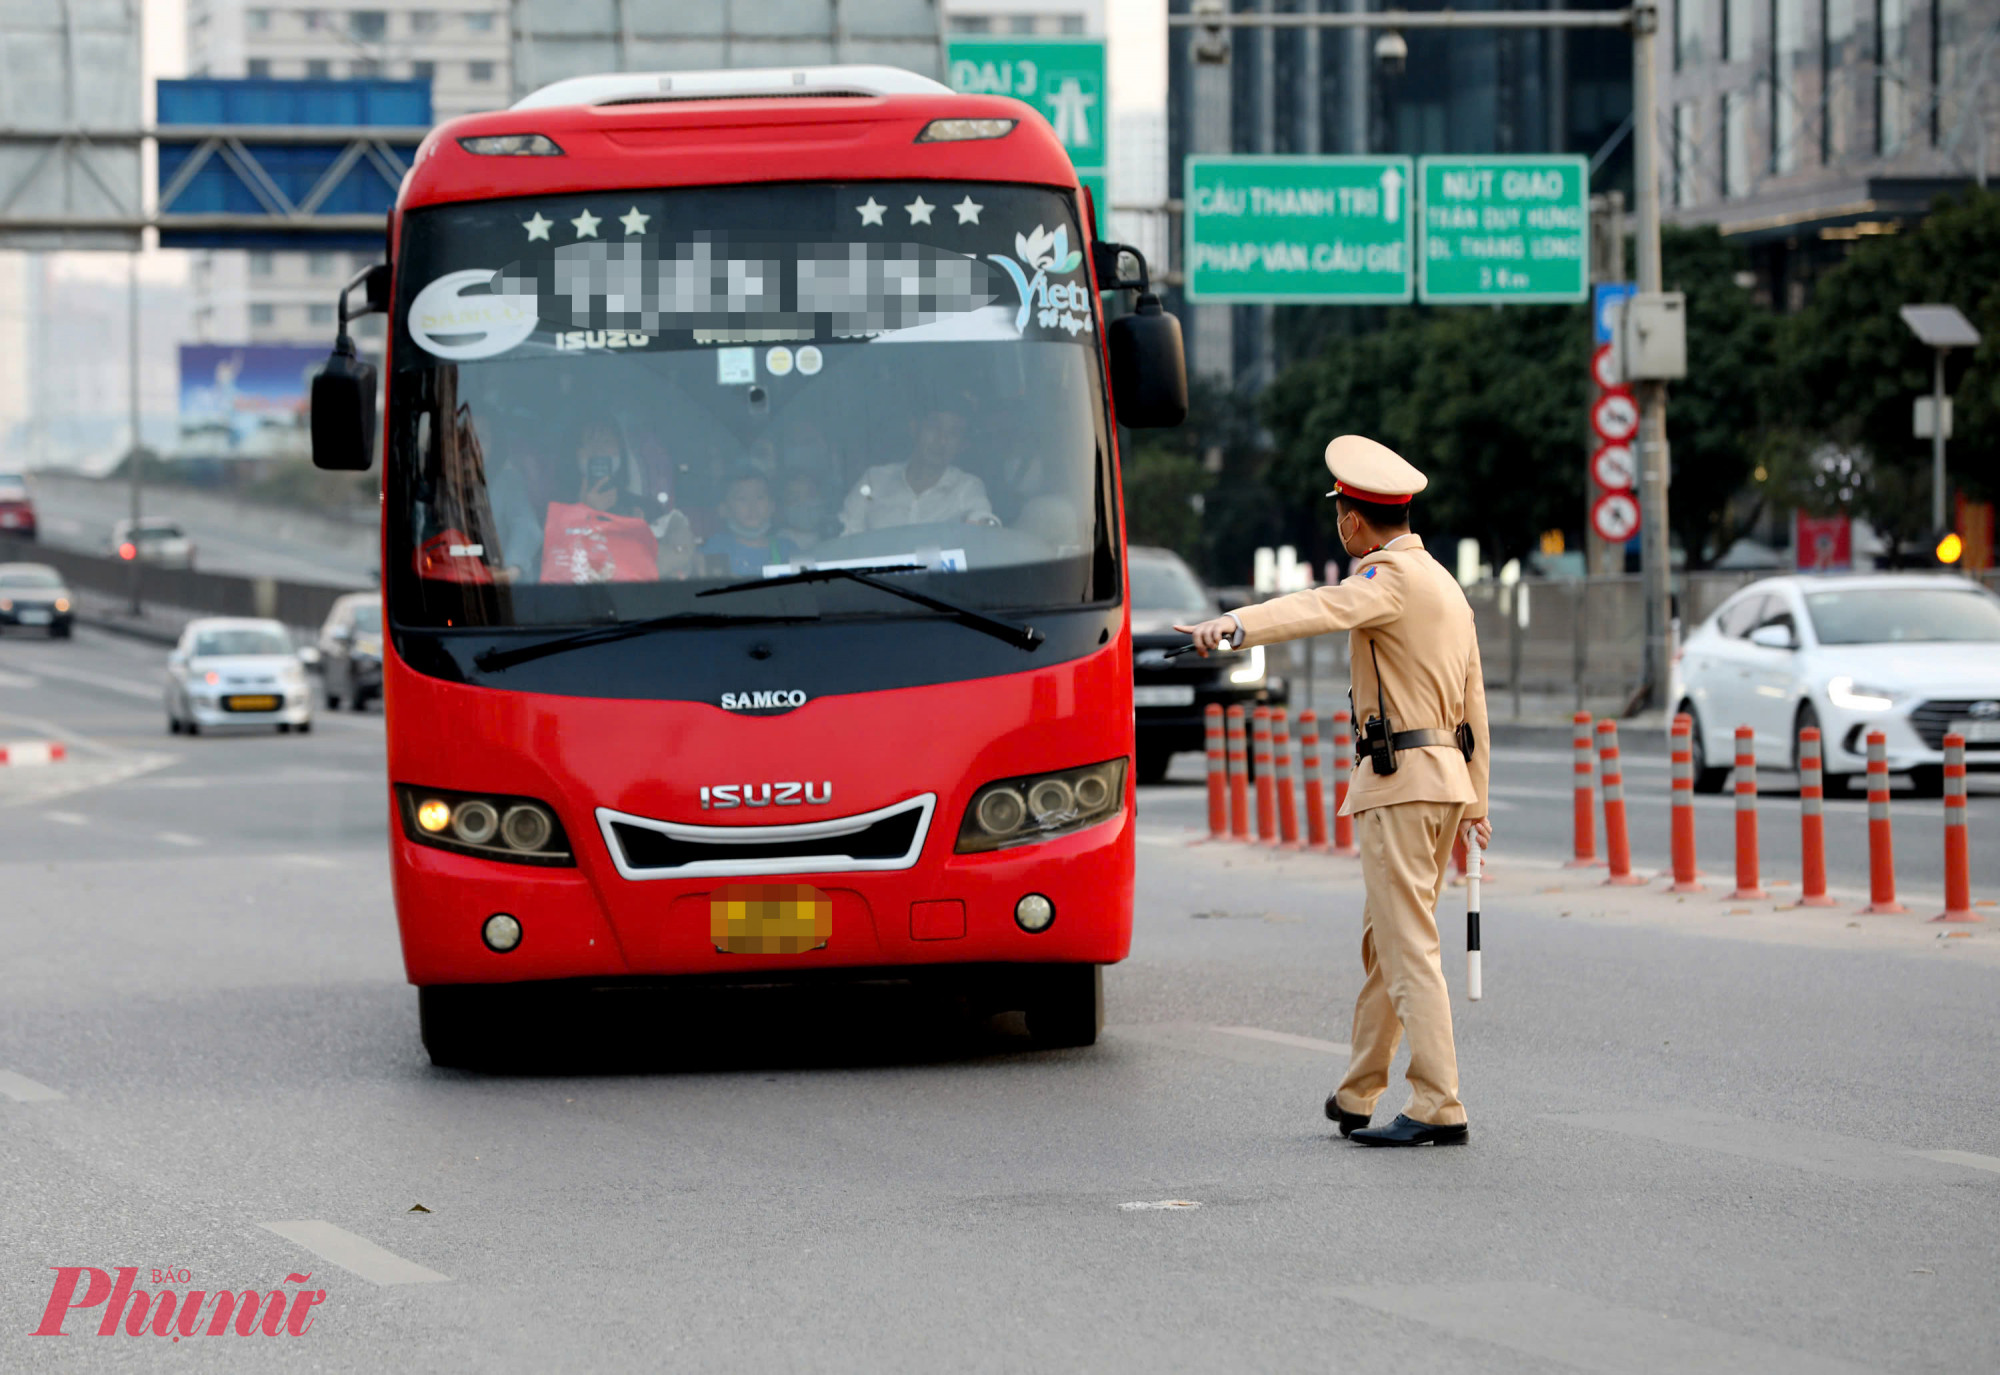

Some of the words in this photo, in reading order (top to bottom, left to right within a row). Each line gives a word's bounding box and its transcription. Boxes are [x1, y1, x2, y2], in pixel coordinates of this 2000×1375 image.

[1501, 168, 1564, 201] GIAO
[555, 330, 649, 351] ISUZU
[721, 690, 806, 710] SAMCO
[700, 781, 832, 810] ISUZU
